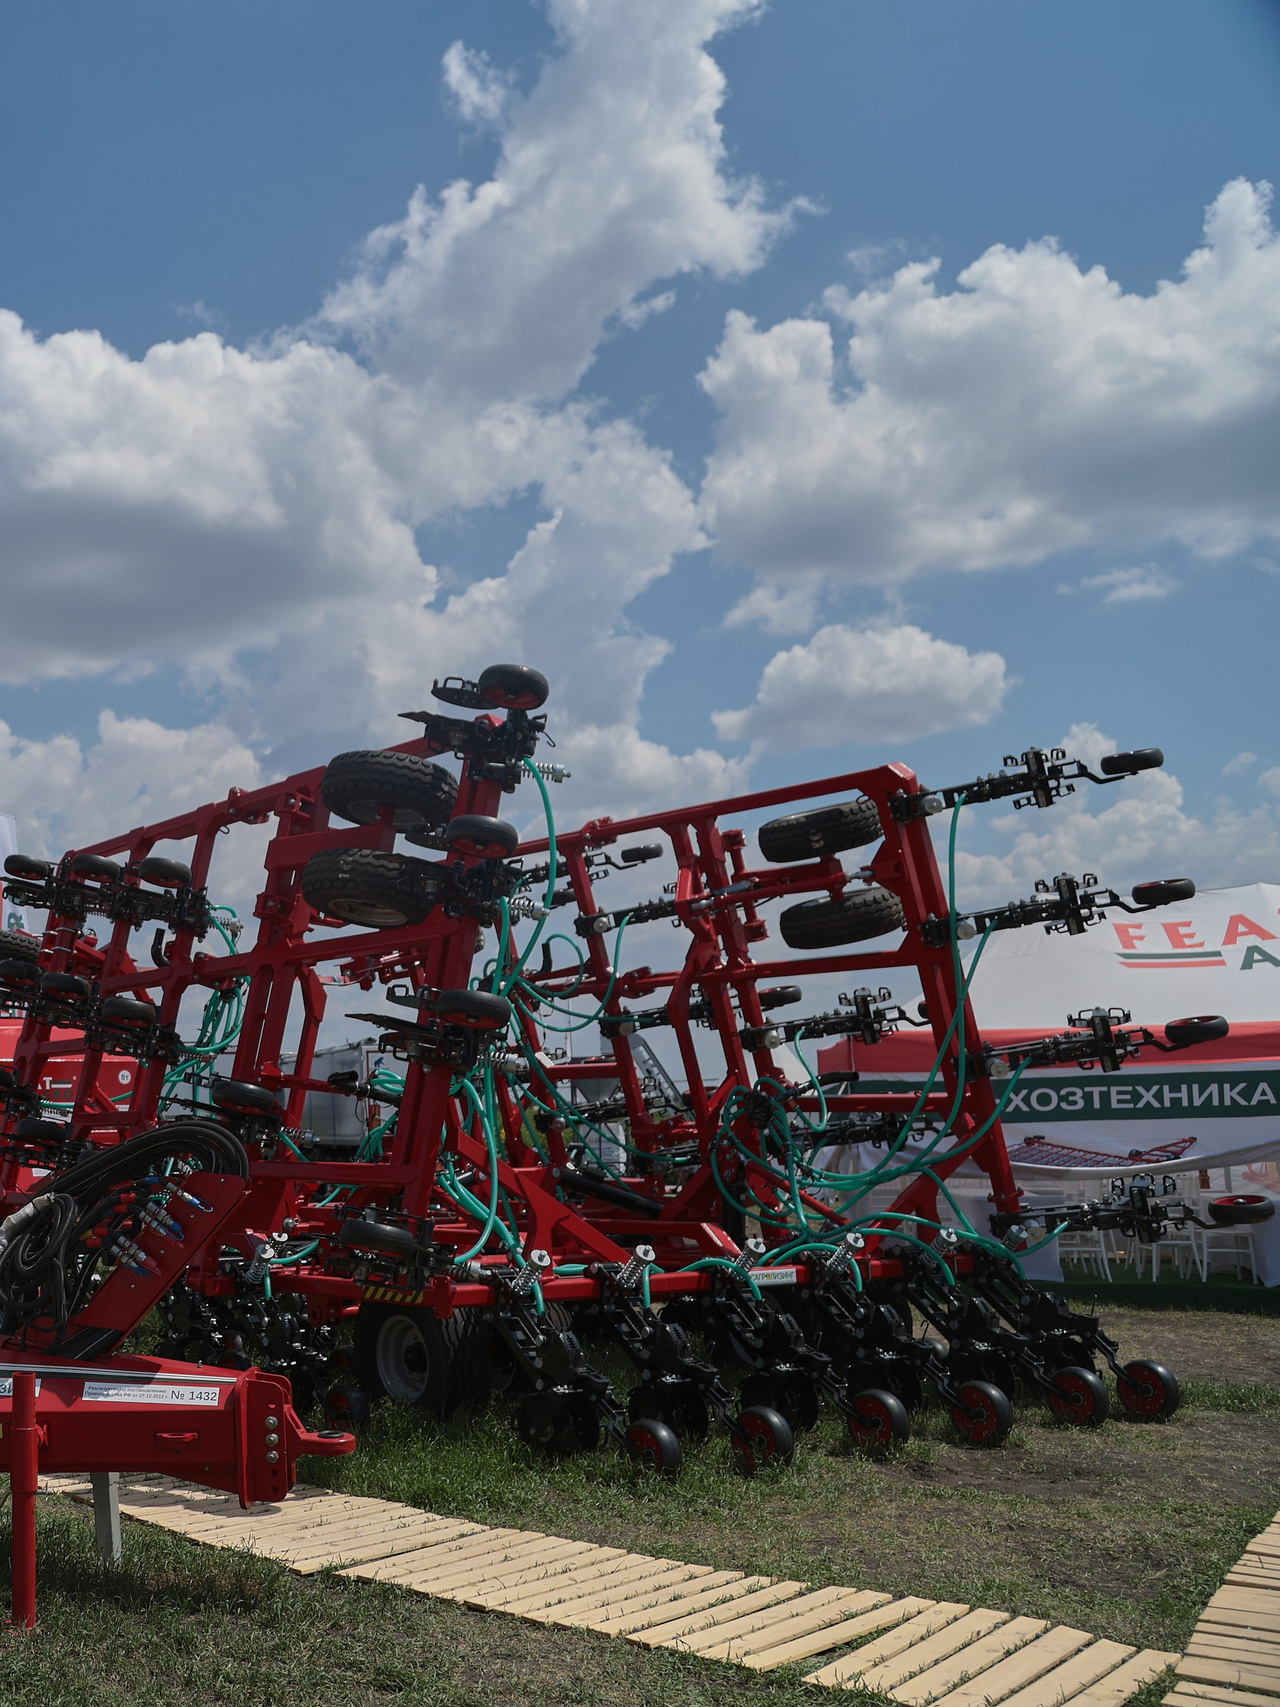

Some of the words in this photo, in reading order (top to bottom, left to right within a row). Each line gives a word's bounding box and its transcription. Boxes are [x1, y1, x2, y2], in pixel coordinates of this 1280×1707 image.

[1112, 907, 1280, 950] FEA
[996, 1082, 1277, 1113] ХОЗТЕХНИКА
[751, 1271, 795, 1281] САГРОЛИЗИНГ
[170, 1390, 185, 1400] №
[189, 1391, 217, 1402] 1432
